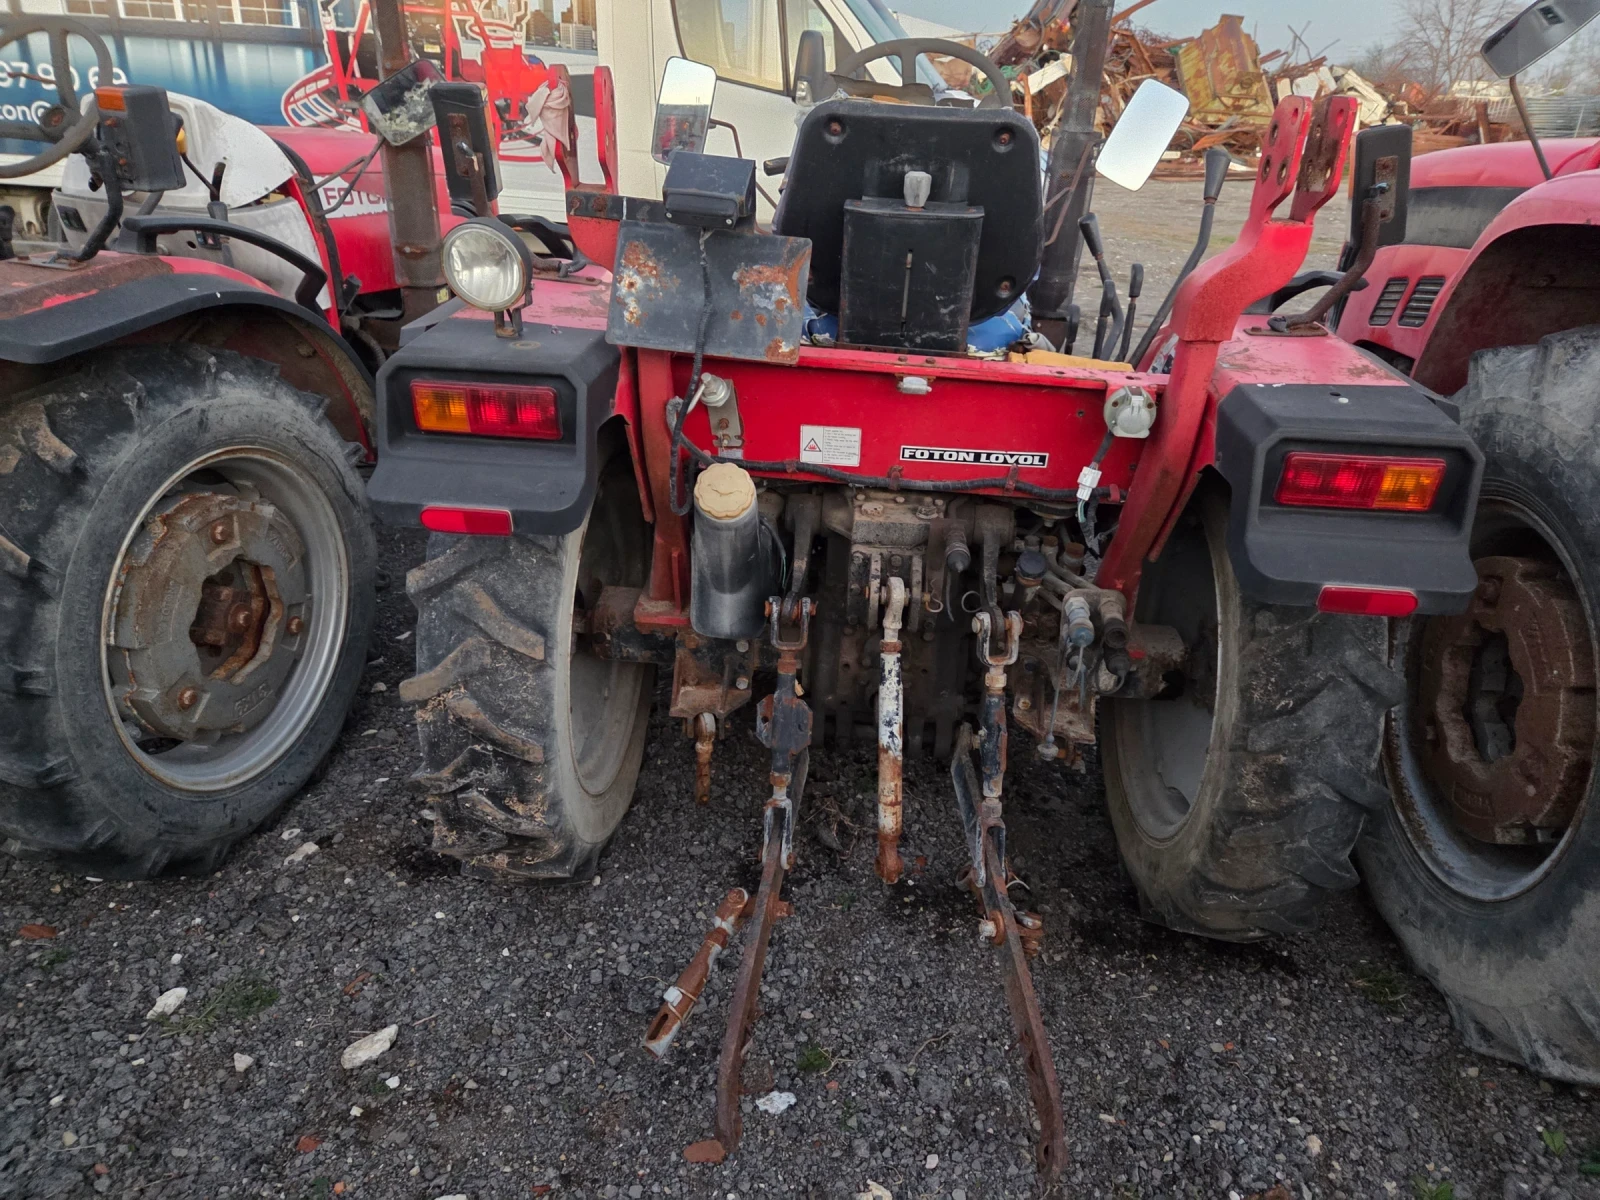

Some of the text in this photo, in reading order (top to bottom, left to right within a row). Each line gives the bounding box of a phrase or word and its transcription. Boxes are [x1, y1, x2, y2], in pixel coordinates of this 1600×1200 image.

[0, 100, 51, 125] on@
[323, 187, 386, 206] FOTO
[903, 448, 1044, 465] FOTON LOVOL
